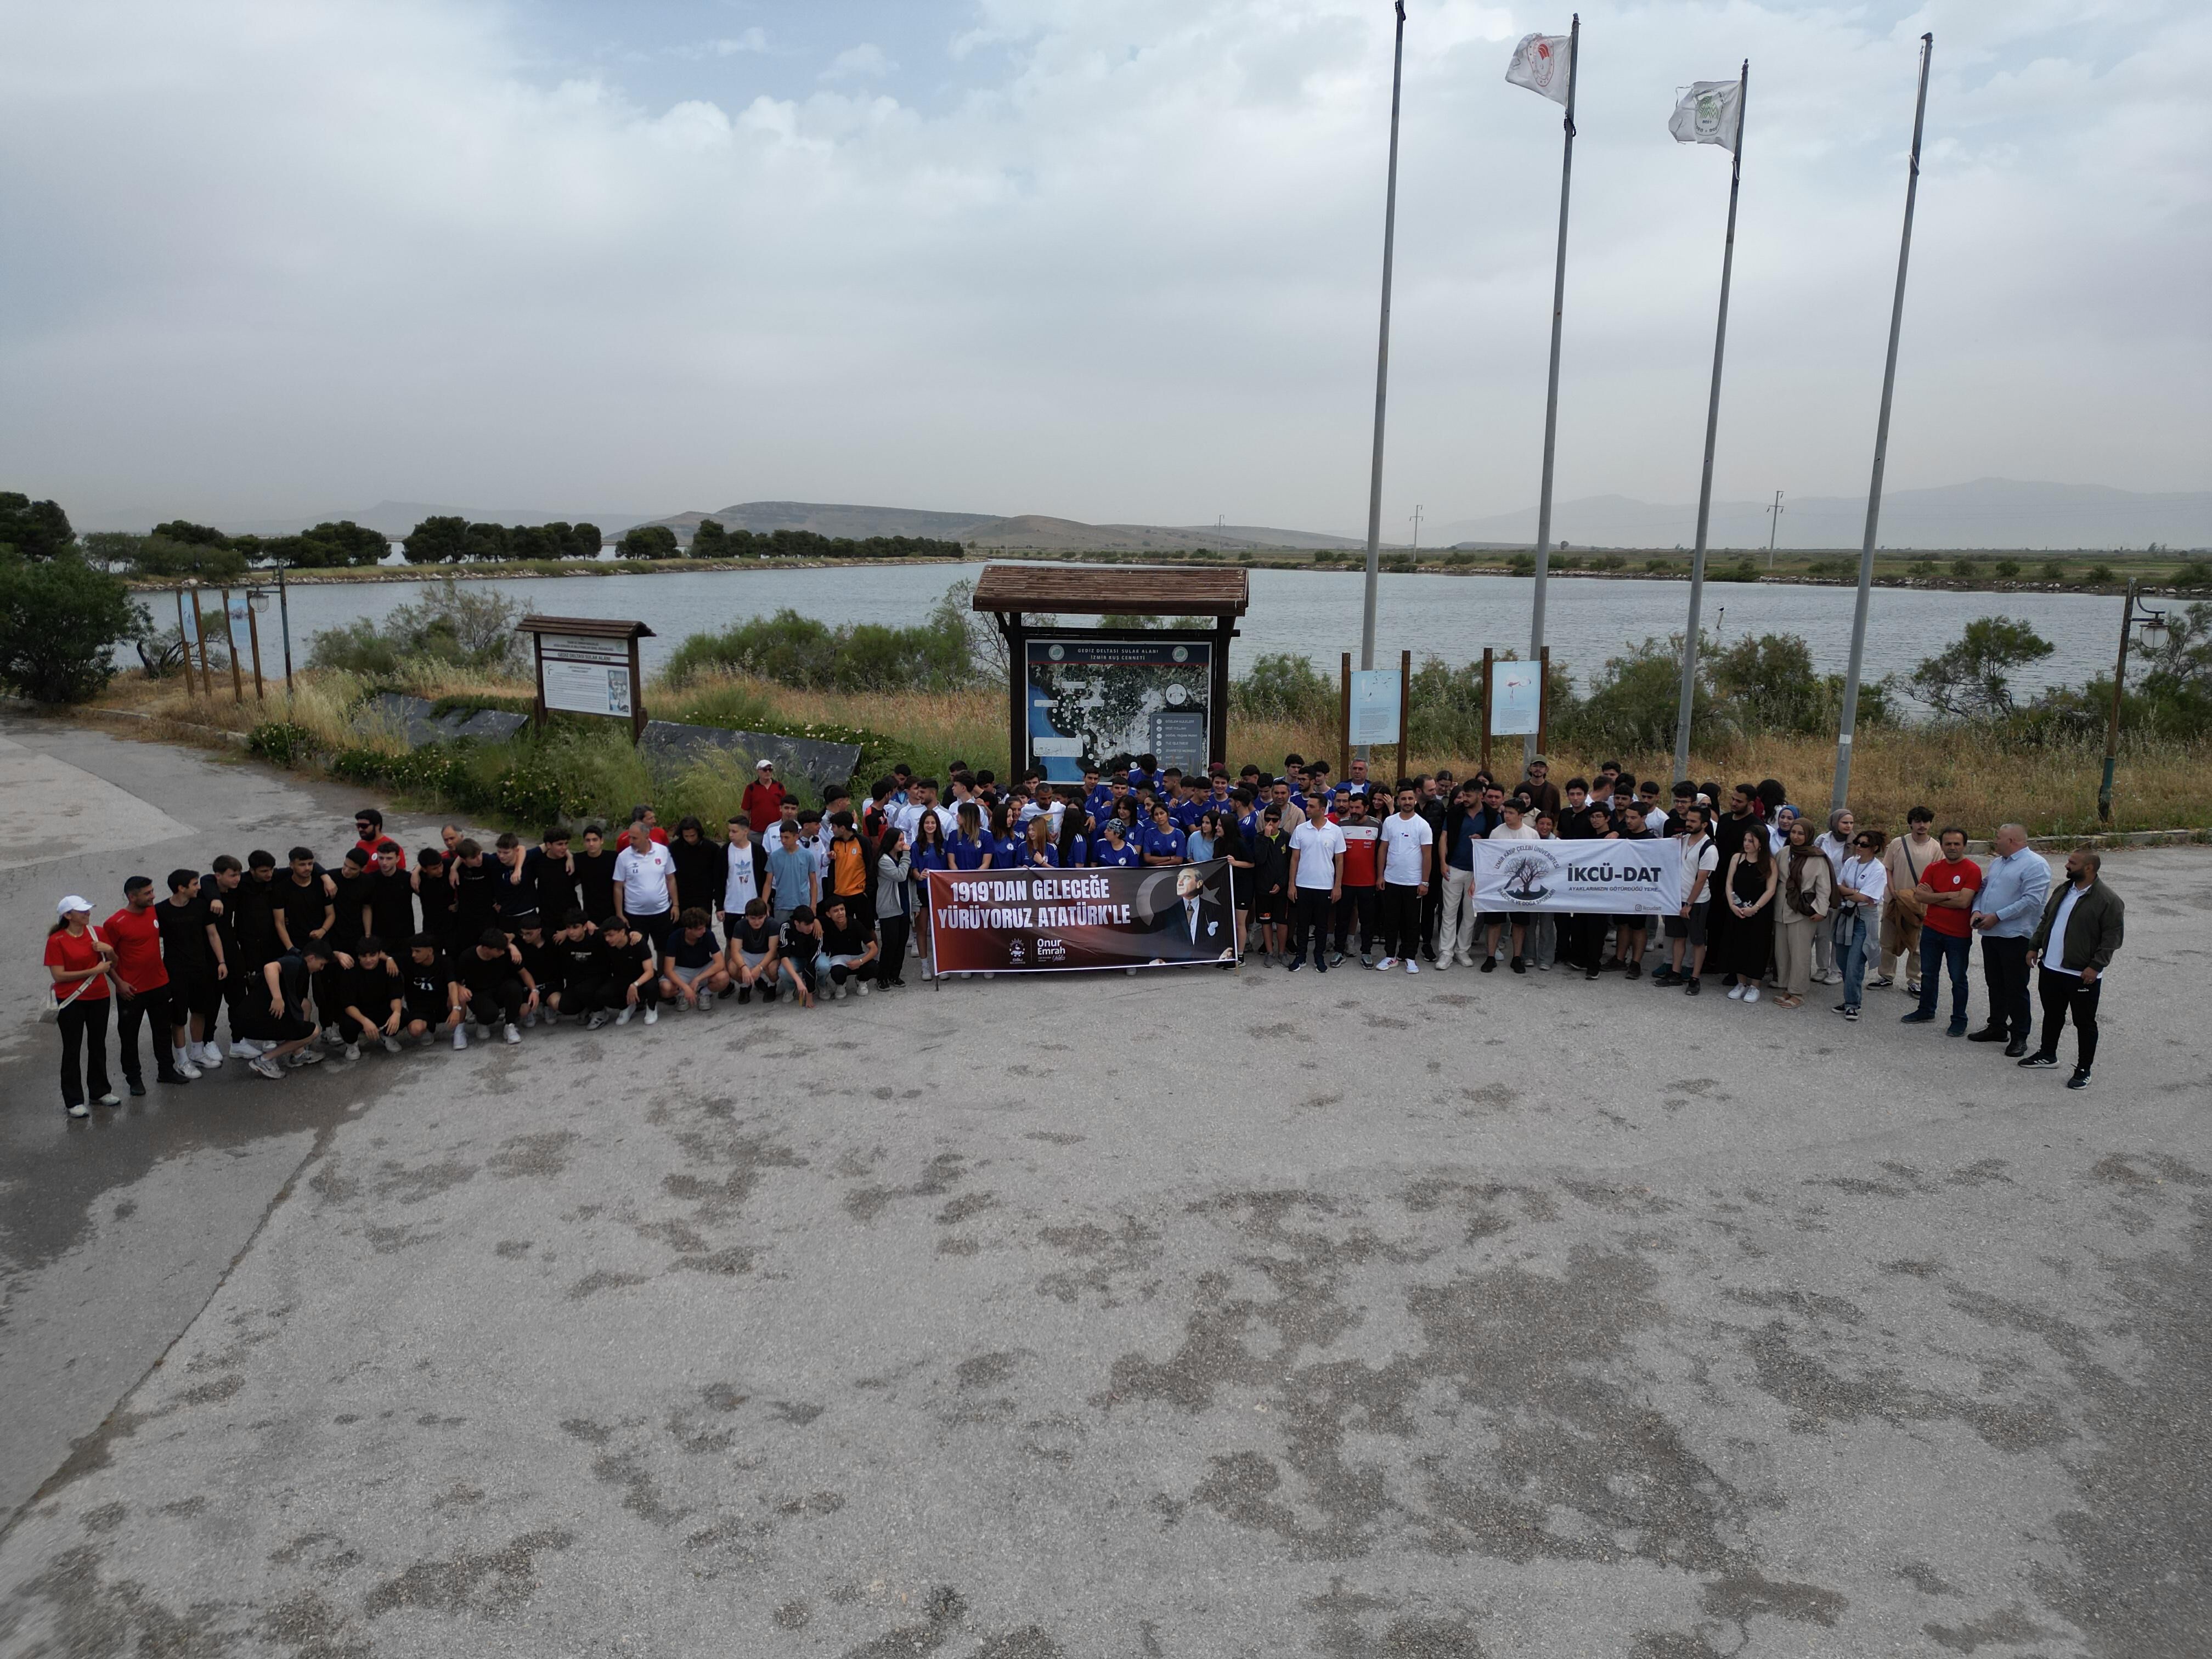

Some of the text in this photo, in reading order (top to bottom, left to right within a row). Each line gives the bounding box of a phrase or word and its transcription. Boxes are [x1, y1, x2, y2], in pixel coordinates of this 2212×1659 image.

[1567, 862, 1662, 882] İKCÜ-DAT
[950, 874, 1110, 902] 1919'DAN GELECEĞE
[937, 901, 1131, 929] YÜRÜYORUZ ATATÜRK'LE
[1037, 938, 1062, 947] Onur
[1037, 946, 1066, 955] Emrah
